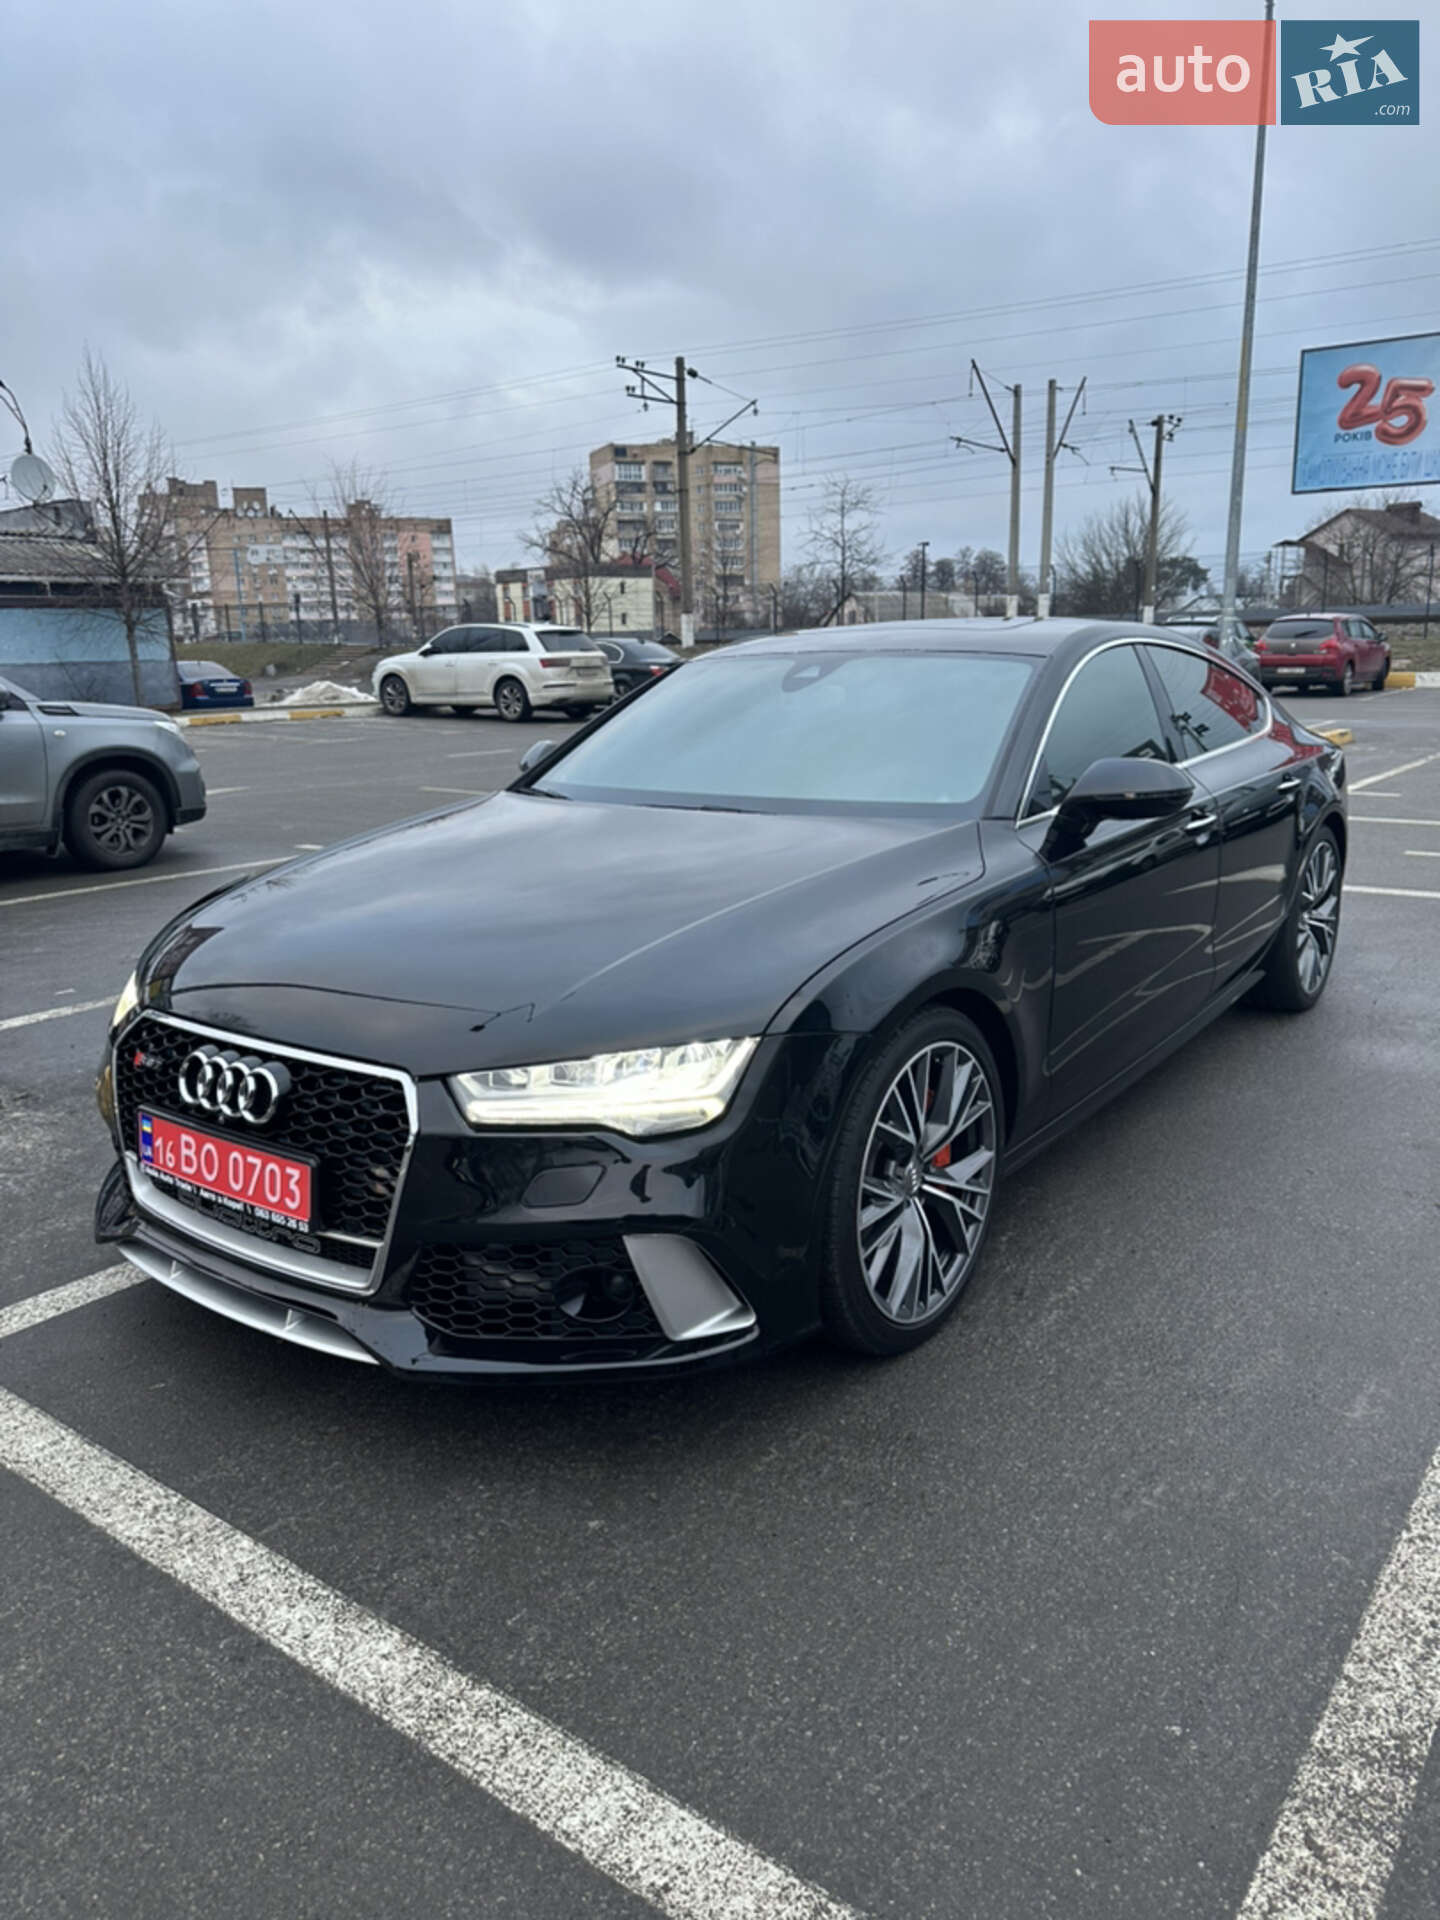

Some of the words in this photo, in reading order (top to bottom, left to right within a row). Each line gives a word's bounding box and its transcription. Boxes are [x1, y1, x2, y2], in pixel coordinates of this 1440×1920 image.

[1333, 430, 1373, 444] РОКІВ
[1337, 363, 1435, 446] 25
[154, 1136, 176, 1169] 16
[228, 1150, 301, 1211] 0703
